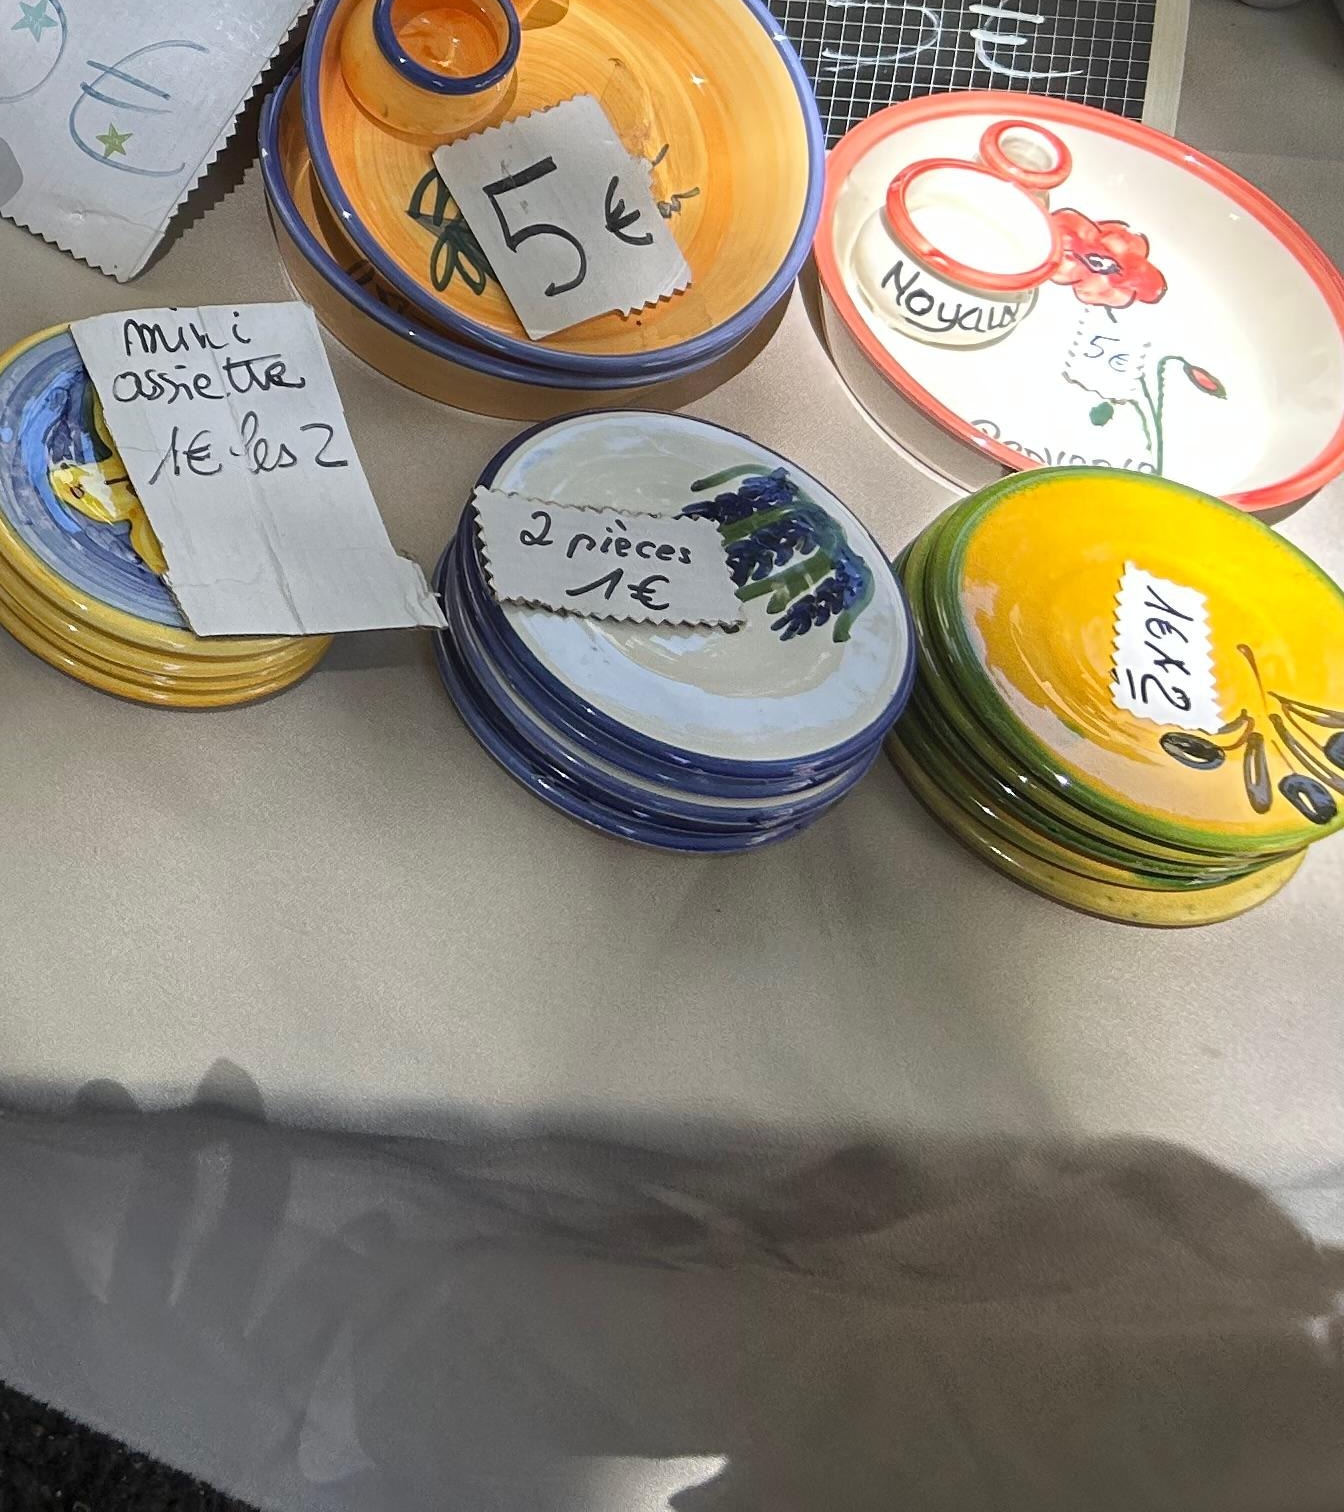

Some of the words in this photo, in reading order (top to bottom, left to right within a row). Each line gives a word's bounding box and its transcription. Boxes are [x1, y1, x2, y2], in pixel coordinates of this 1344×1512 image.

[482, 155, 654, 297] 5€
[1083, 334, 1131, 372] 5€
[299, 422, 348, 468] 2
[519, 510, 553, 546] 2
[565, 518, 692, 565] pièces
[564, 567, 670, 611] 1€
